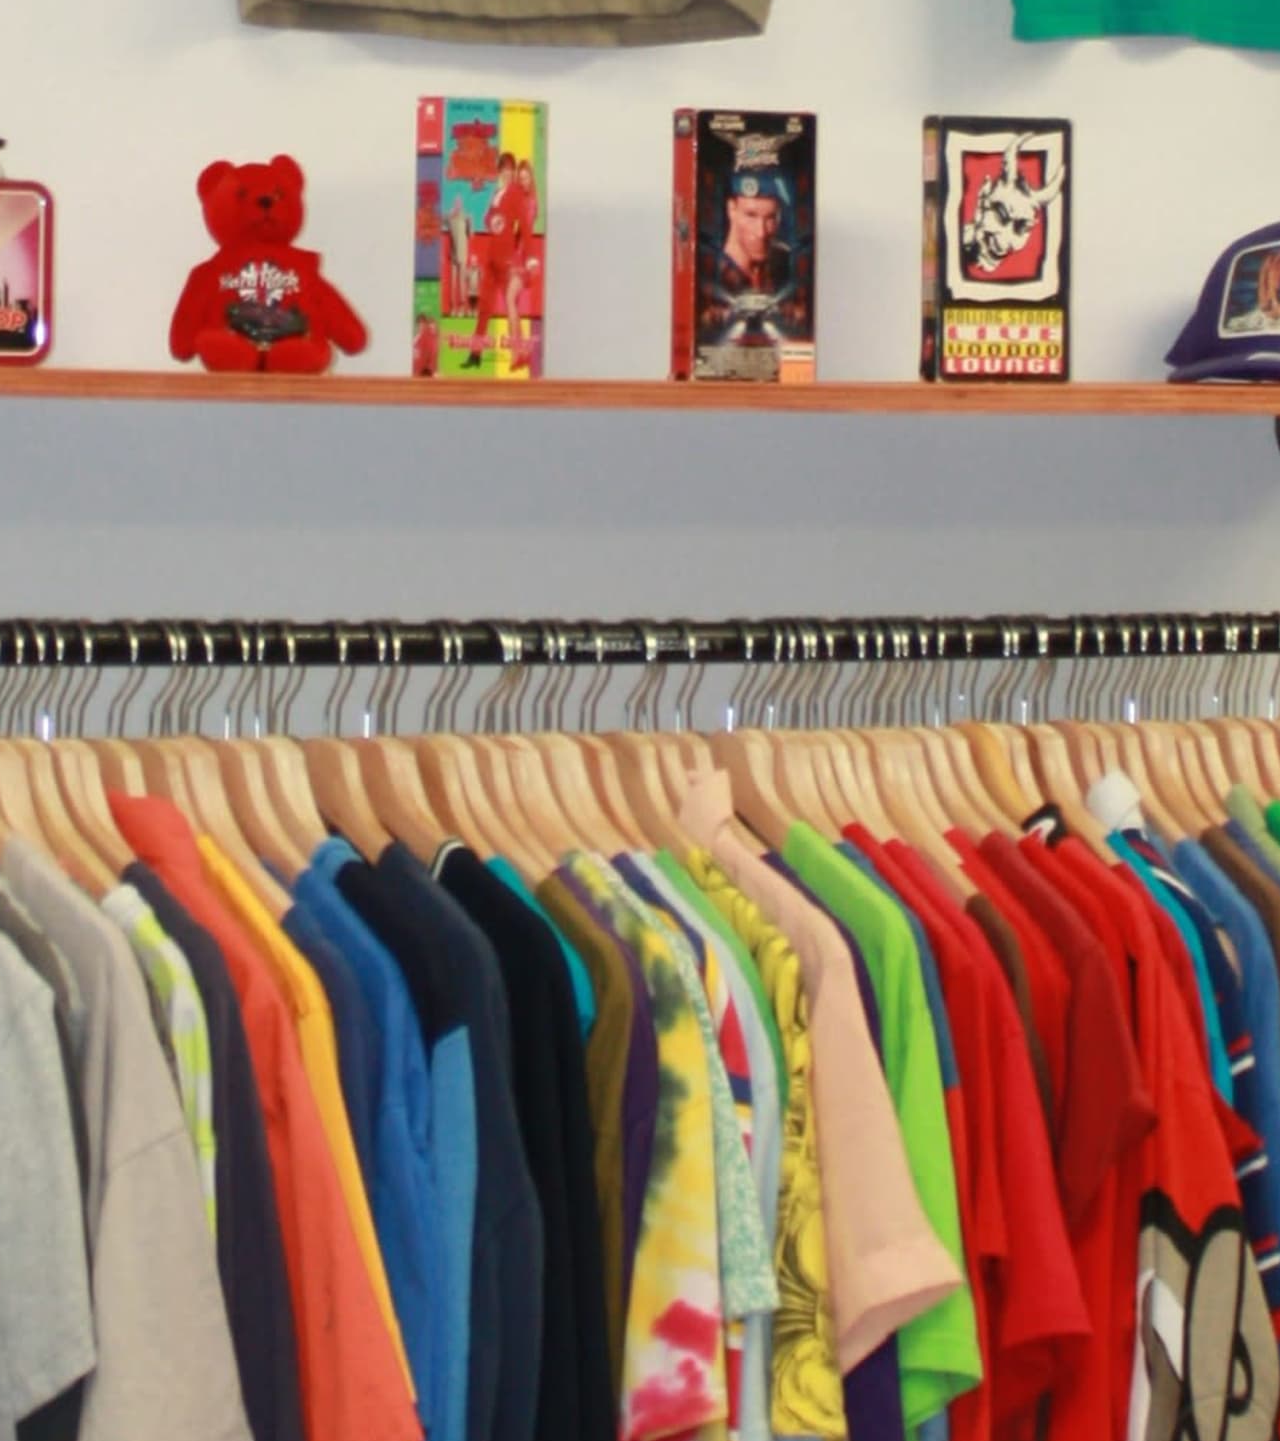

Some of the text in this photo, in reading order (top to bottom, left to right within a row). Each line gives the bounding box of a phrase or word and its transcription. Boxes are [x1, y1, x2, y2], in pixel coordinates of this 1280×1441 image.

[946, 309, 1061, 326] ROLLING STONES
[947, 341, 1060, 358] VOODOO
[945, 357, 1062, 374] LOUNGE
